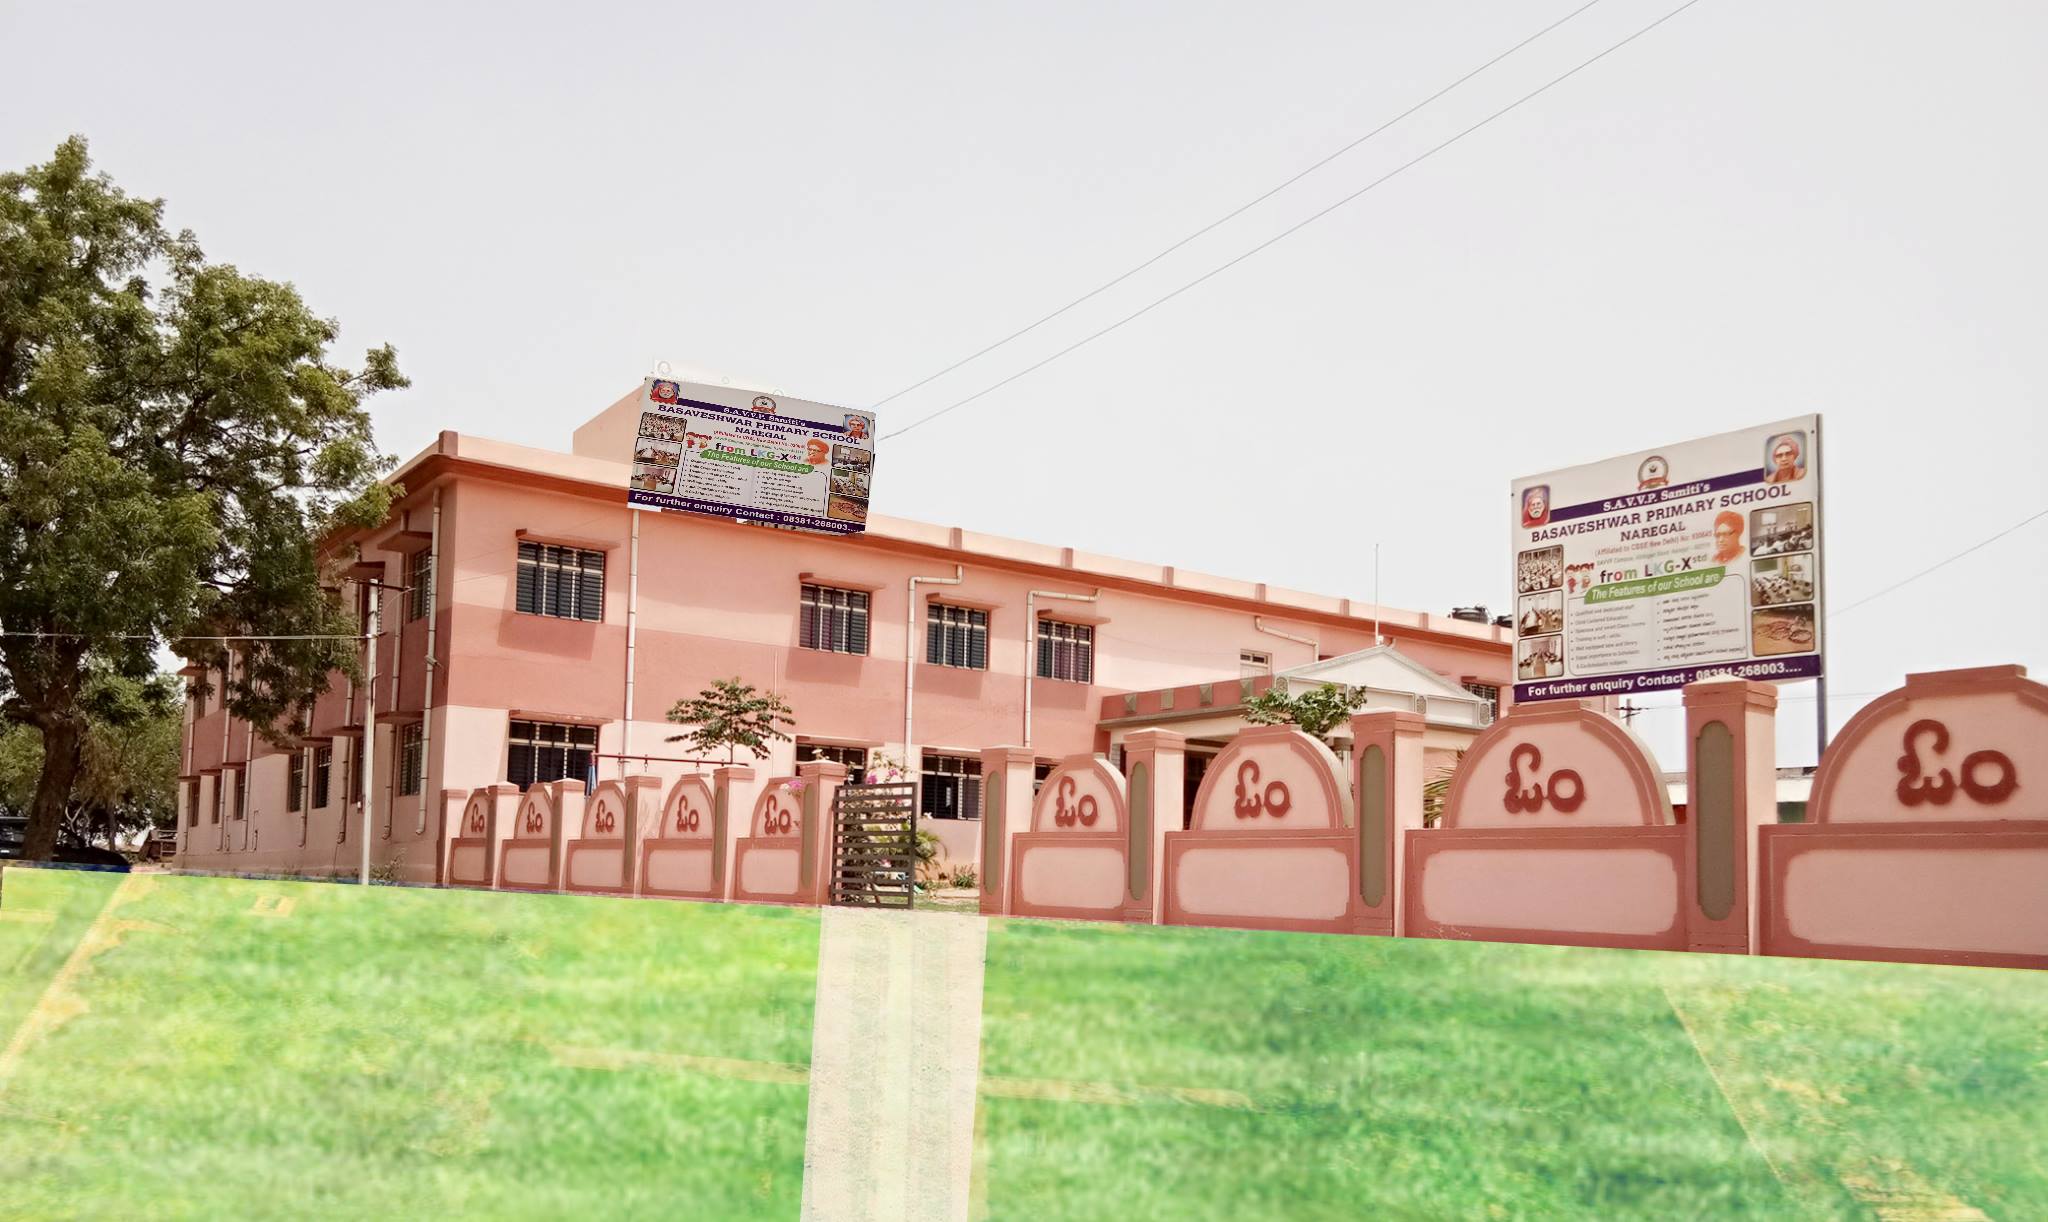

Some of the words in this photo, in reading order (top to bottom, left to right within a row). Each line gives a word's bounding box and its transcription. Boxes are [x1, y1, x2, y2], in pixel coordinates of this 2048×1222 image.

[658, 405, 752, 427] BASAVESHWAR
[756, 422, 810, 437] PRIMARY
[812, 432, 860, 445] SCHOOL
[735, 427, 787, 441] NAREGAL
[707, 450, 721, 460] The
[722, 452, 751, 464] Features
[751, 458, 760, 467] of
[760, 460, 773, 468] our
[774, 460, 797, 471] School
[715, 443, 746, 456] from
[634, 493, 654, 503] For
[655, 495, 692, 508] further
[693, 503, 733, 515] enquiry
[735, 508, 775, 521] Contact
[1603, 491, 1657, 512] S.A.V.V.P.
[1660, 482, 1711, 502] Samiti's
[1531, 511, 1641, 543] BASAVESHWAR
[1646, 499, 1716, 523] PRIMARY
[1720, 484, 1792, 508] SCHOOL
[1620, 521, 1686, 543] NAREGAL
[1592, 589, 1608, 600] The
[1608, 584, 1646, 598] Features
[1648, 581, 1657, 592] of
[1657, 580, 1673, 591] our
[1673, 574, 1705, 589] School
[1705, 572, 1720, 584] are
[1600, 569, 1637, 584] from
[1528, 686, 1548, 697] For
[1549, 682, 1587, 695] further
[1590, 679, 1634, 694] enquiry
[1637, 673, 1685, 689] Contact
[1895, 718, 2019, 806] ಓಂ
[1233, 760, 1292, 819] ಓಂ
[1503, 742, 1585, 815] ಓಂ
[526, 801, 543, 833] ಓಂ
[595, 799, 615, 833] ಓಂ
[677, 795, 699, 832] ಓಂ
[765, 795, 792, 834] ಓಂ
[1054, 775, 1099, 829] ಓಂ
[470, 803, 485, 833] ಓಂ
